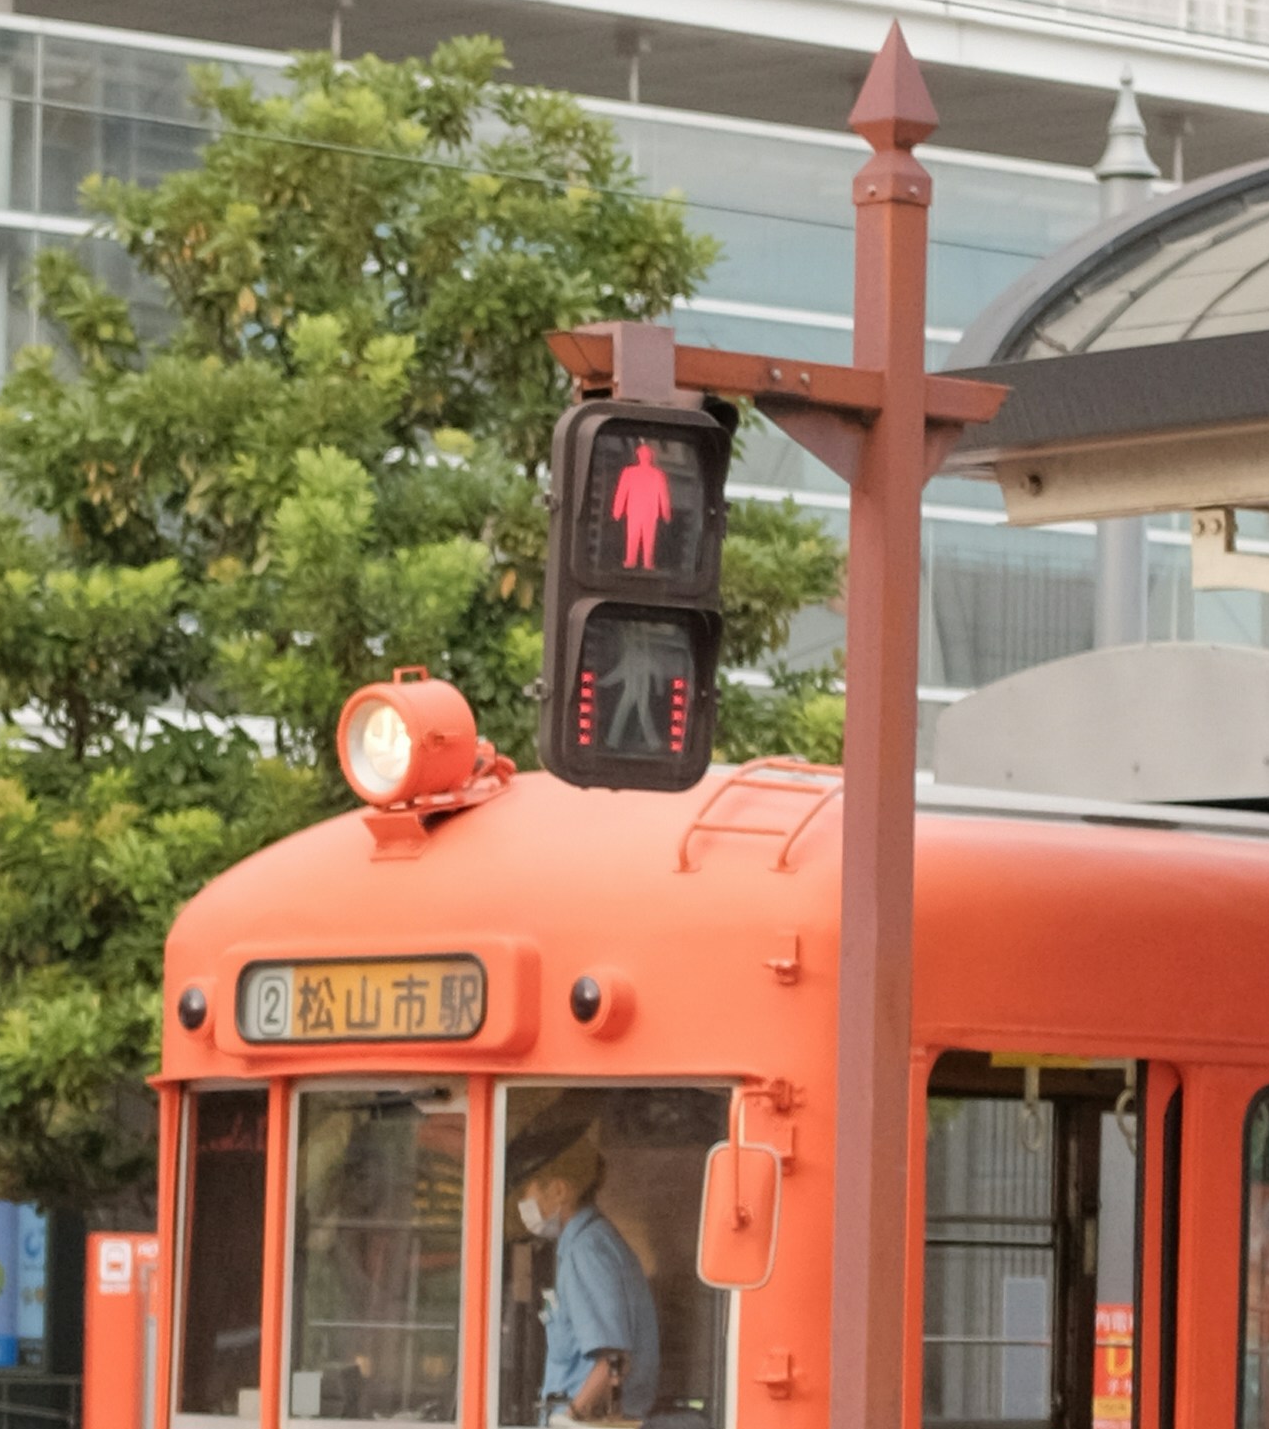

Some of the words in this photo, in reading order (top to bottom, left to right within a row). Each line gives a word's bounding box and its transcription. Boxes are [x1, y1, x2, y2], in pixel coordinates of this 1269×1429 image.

[263, 985, 281, 1025] 2
[297, 973, 480, 1033] 松山市駅
